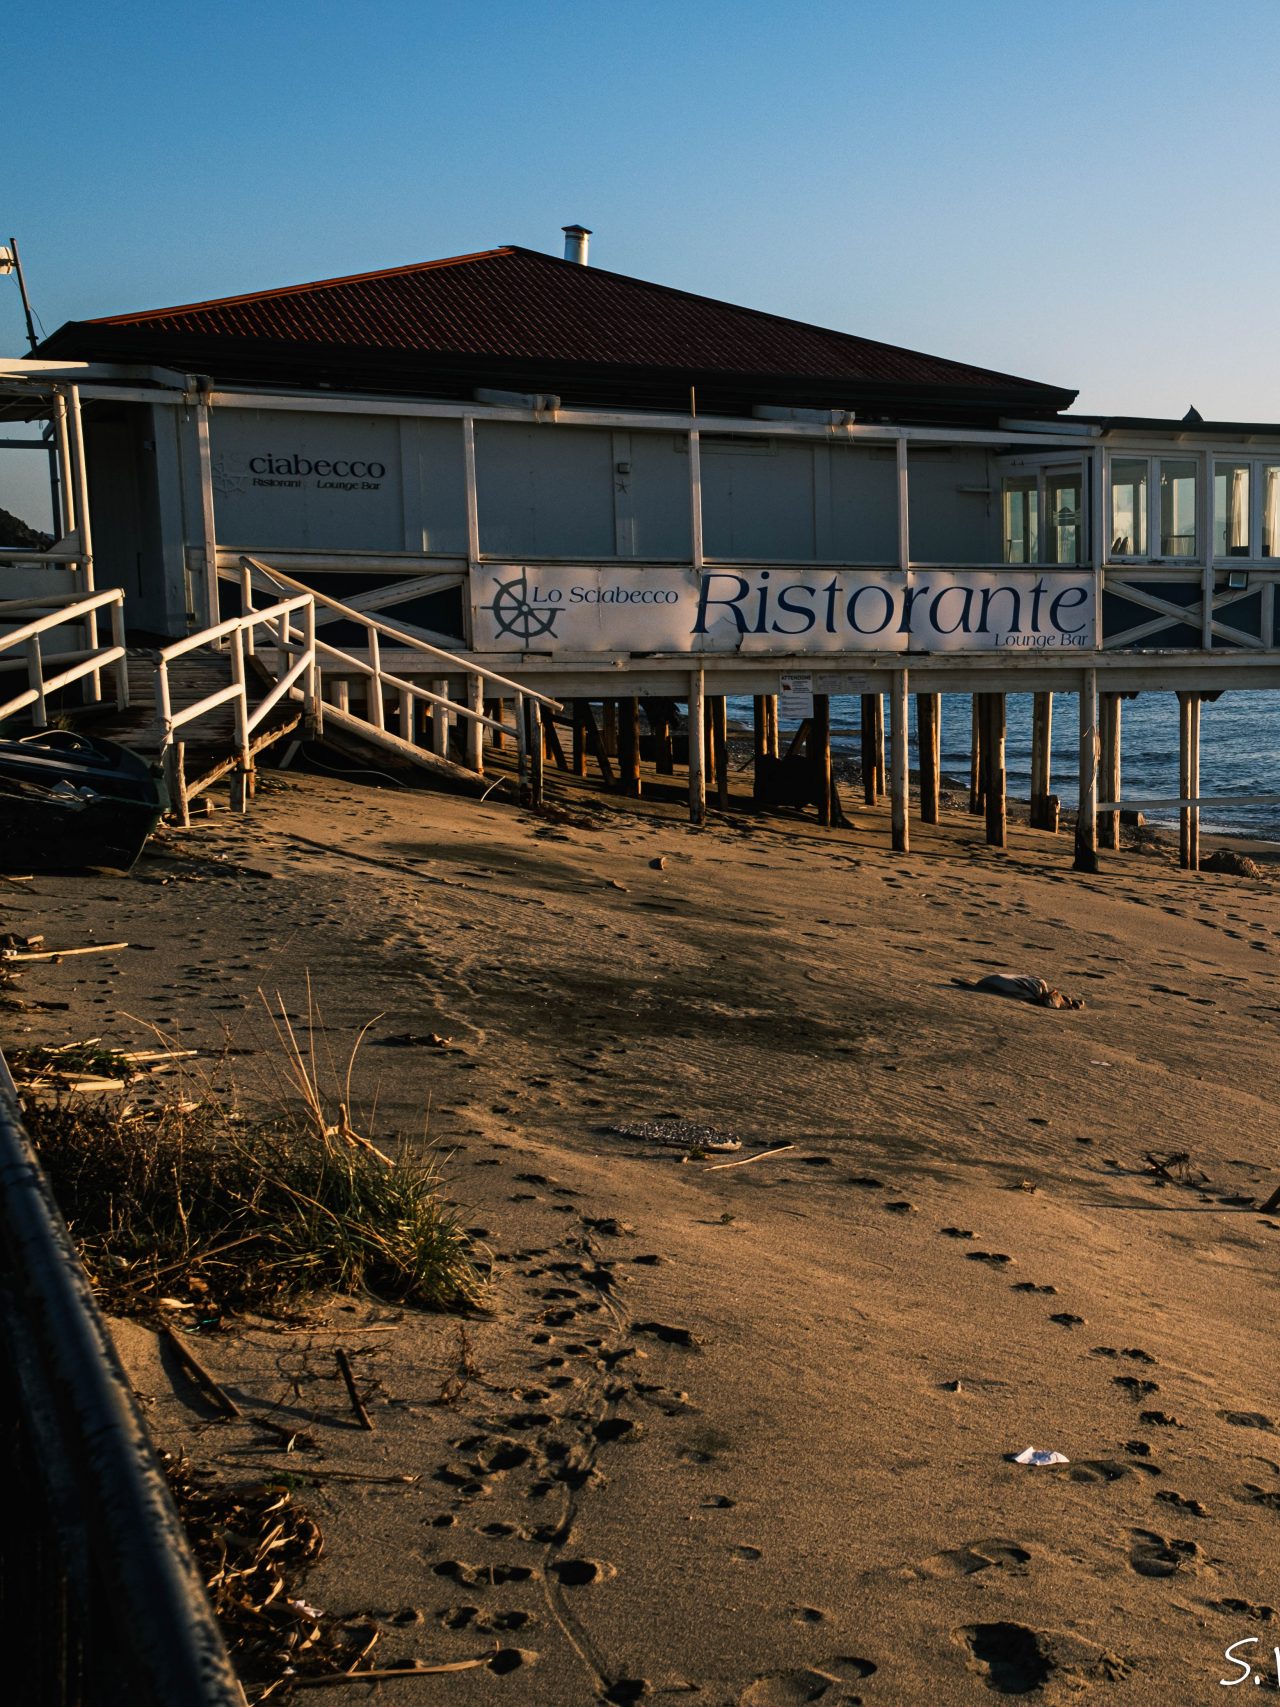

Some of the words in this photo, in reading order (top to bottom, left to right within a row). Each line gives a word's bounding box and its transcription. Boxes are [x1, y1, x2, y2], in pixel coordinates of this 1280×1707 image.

[317, 479, 360, 491] Lounge
[361, 481, 381, 490] Bar
[532, 586, 562, 603] Lo
[569, 586, 679, 605] Sciabecco
[690, 571, 1089, 635] Ristorante
[995, 633, 1056, 648] Lounge
[1060, 633, 1089, 646] Bar
